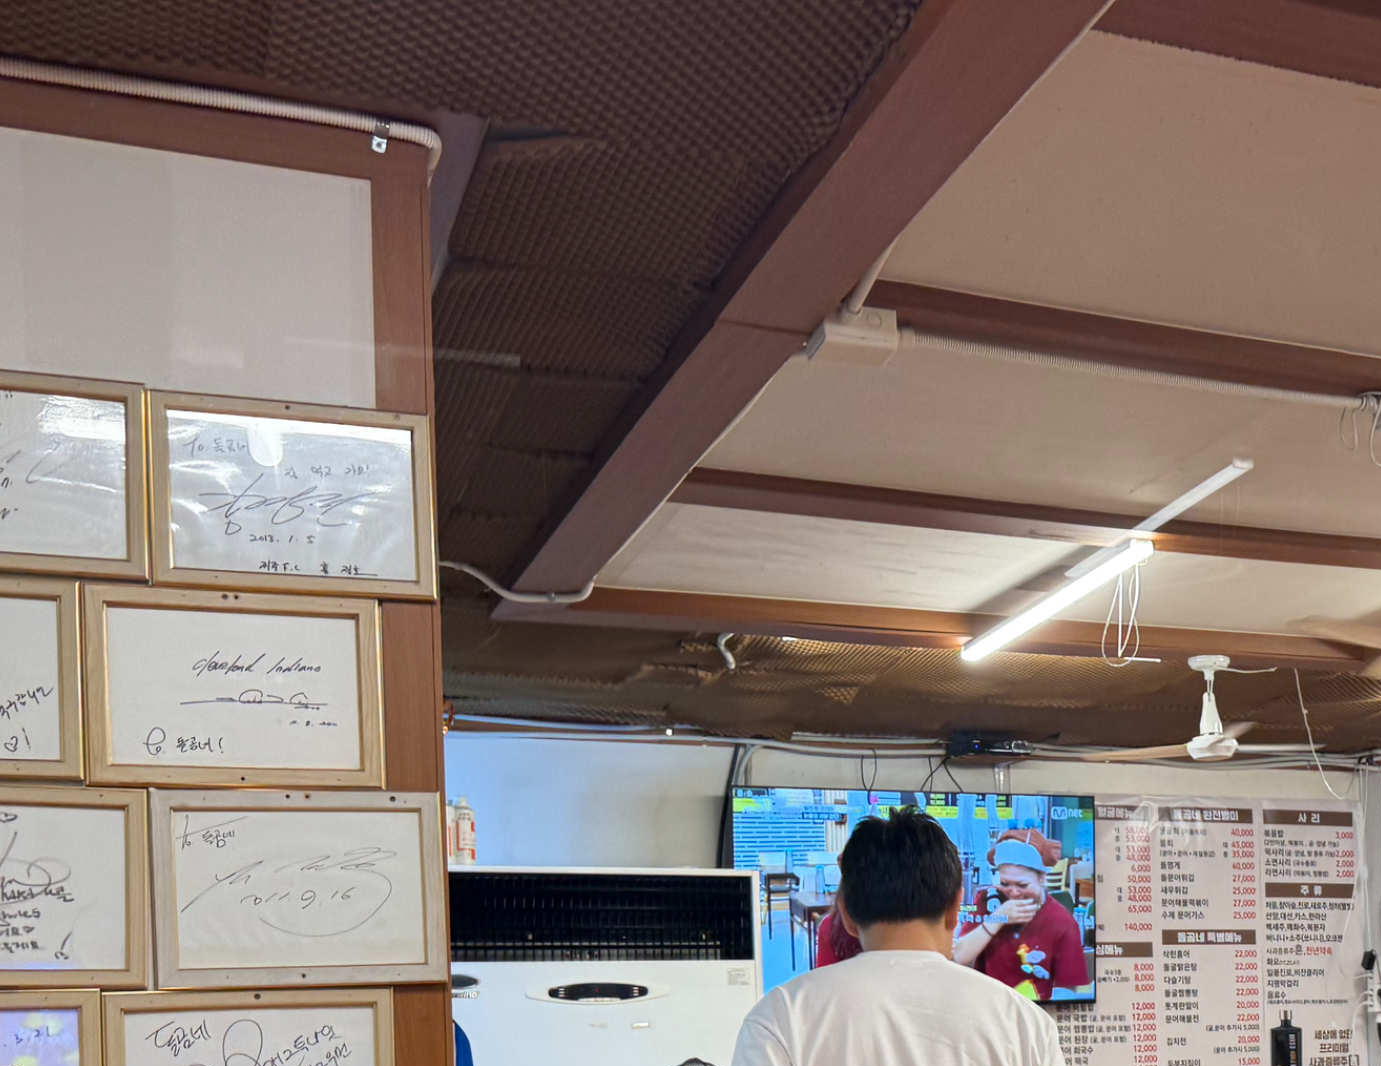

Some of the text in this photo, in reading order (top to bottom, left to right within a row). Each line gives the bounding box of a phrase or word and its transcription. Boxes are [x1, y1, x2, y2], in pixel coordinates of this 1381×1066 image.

[1231, 829, 1254, 837] 40,000
[1231, 841, 1254, 849] 45,000
[1336, 850, 1354, 858] 2,000
[1132, 865, 1151, 873] 6,000
[1232, 863, 1255, 871] 40,000
[1265, 869, 1291, 877] 라면사리
[1128, 875, 1151, 883] 50,000
[1232, 875, 1255, 883] 27,000
[1128, 886, 1151, 894] 53,000
[1233, 887, 1256, 895] 25,000
[1128, 905, 1152, 913] 65,000
[1233, 912, 1256, 920] 25,000
[1125, 923, 1152, 931] 140,000
[1235, 950, 1257, 958] 22,000
[1134, 963, 1154, 971] 8,000
[1235, 963, 1258, 971] 22,000
[1134, 974, 1154, 982] 8,000
[1236, 976, 1258, 984] 22,000
[1135, 984, 1155, 992] 8,000
[1236, 988, 1259, 996] 22,000
[1267, 991, 1286, 999] 음료수
[1132, 1002, 1155, 1011] 12,000
[1237, 1001, 1259, 1009] 20,000
[1132, 1013, 1156, 1021] 12,000
[1237, 1014, 1259, 1022] 22,000
[1132, 1023, 1156, 1032] 12,000
[1133, 1034, 1157, 1043] 12,000
[1314, 1030, 1337, 1039] 세상에
[1167, 1035, 1260, 1046] 김치전 20,000
[1134, 1045, 1157, 1053] 12,000
[1319, 1044, 1349, 1053] 프리미엄
[1134, 1055, 1157, 1063] 12,000
[1239, 1058, 1260, 1066] 15,000
[1309, 1056, 1348, 1066] 사과증류주
